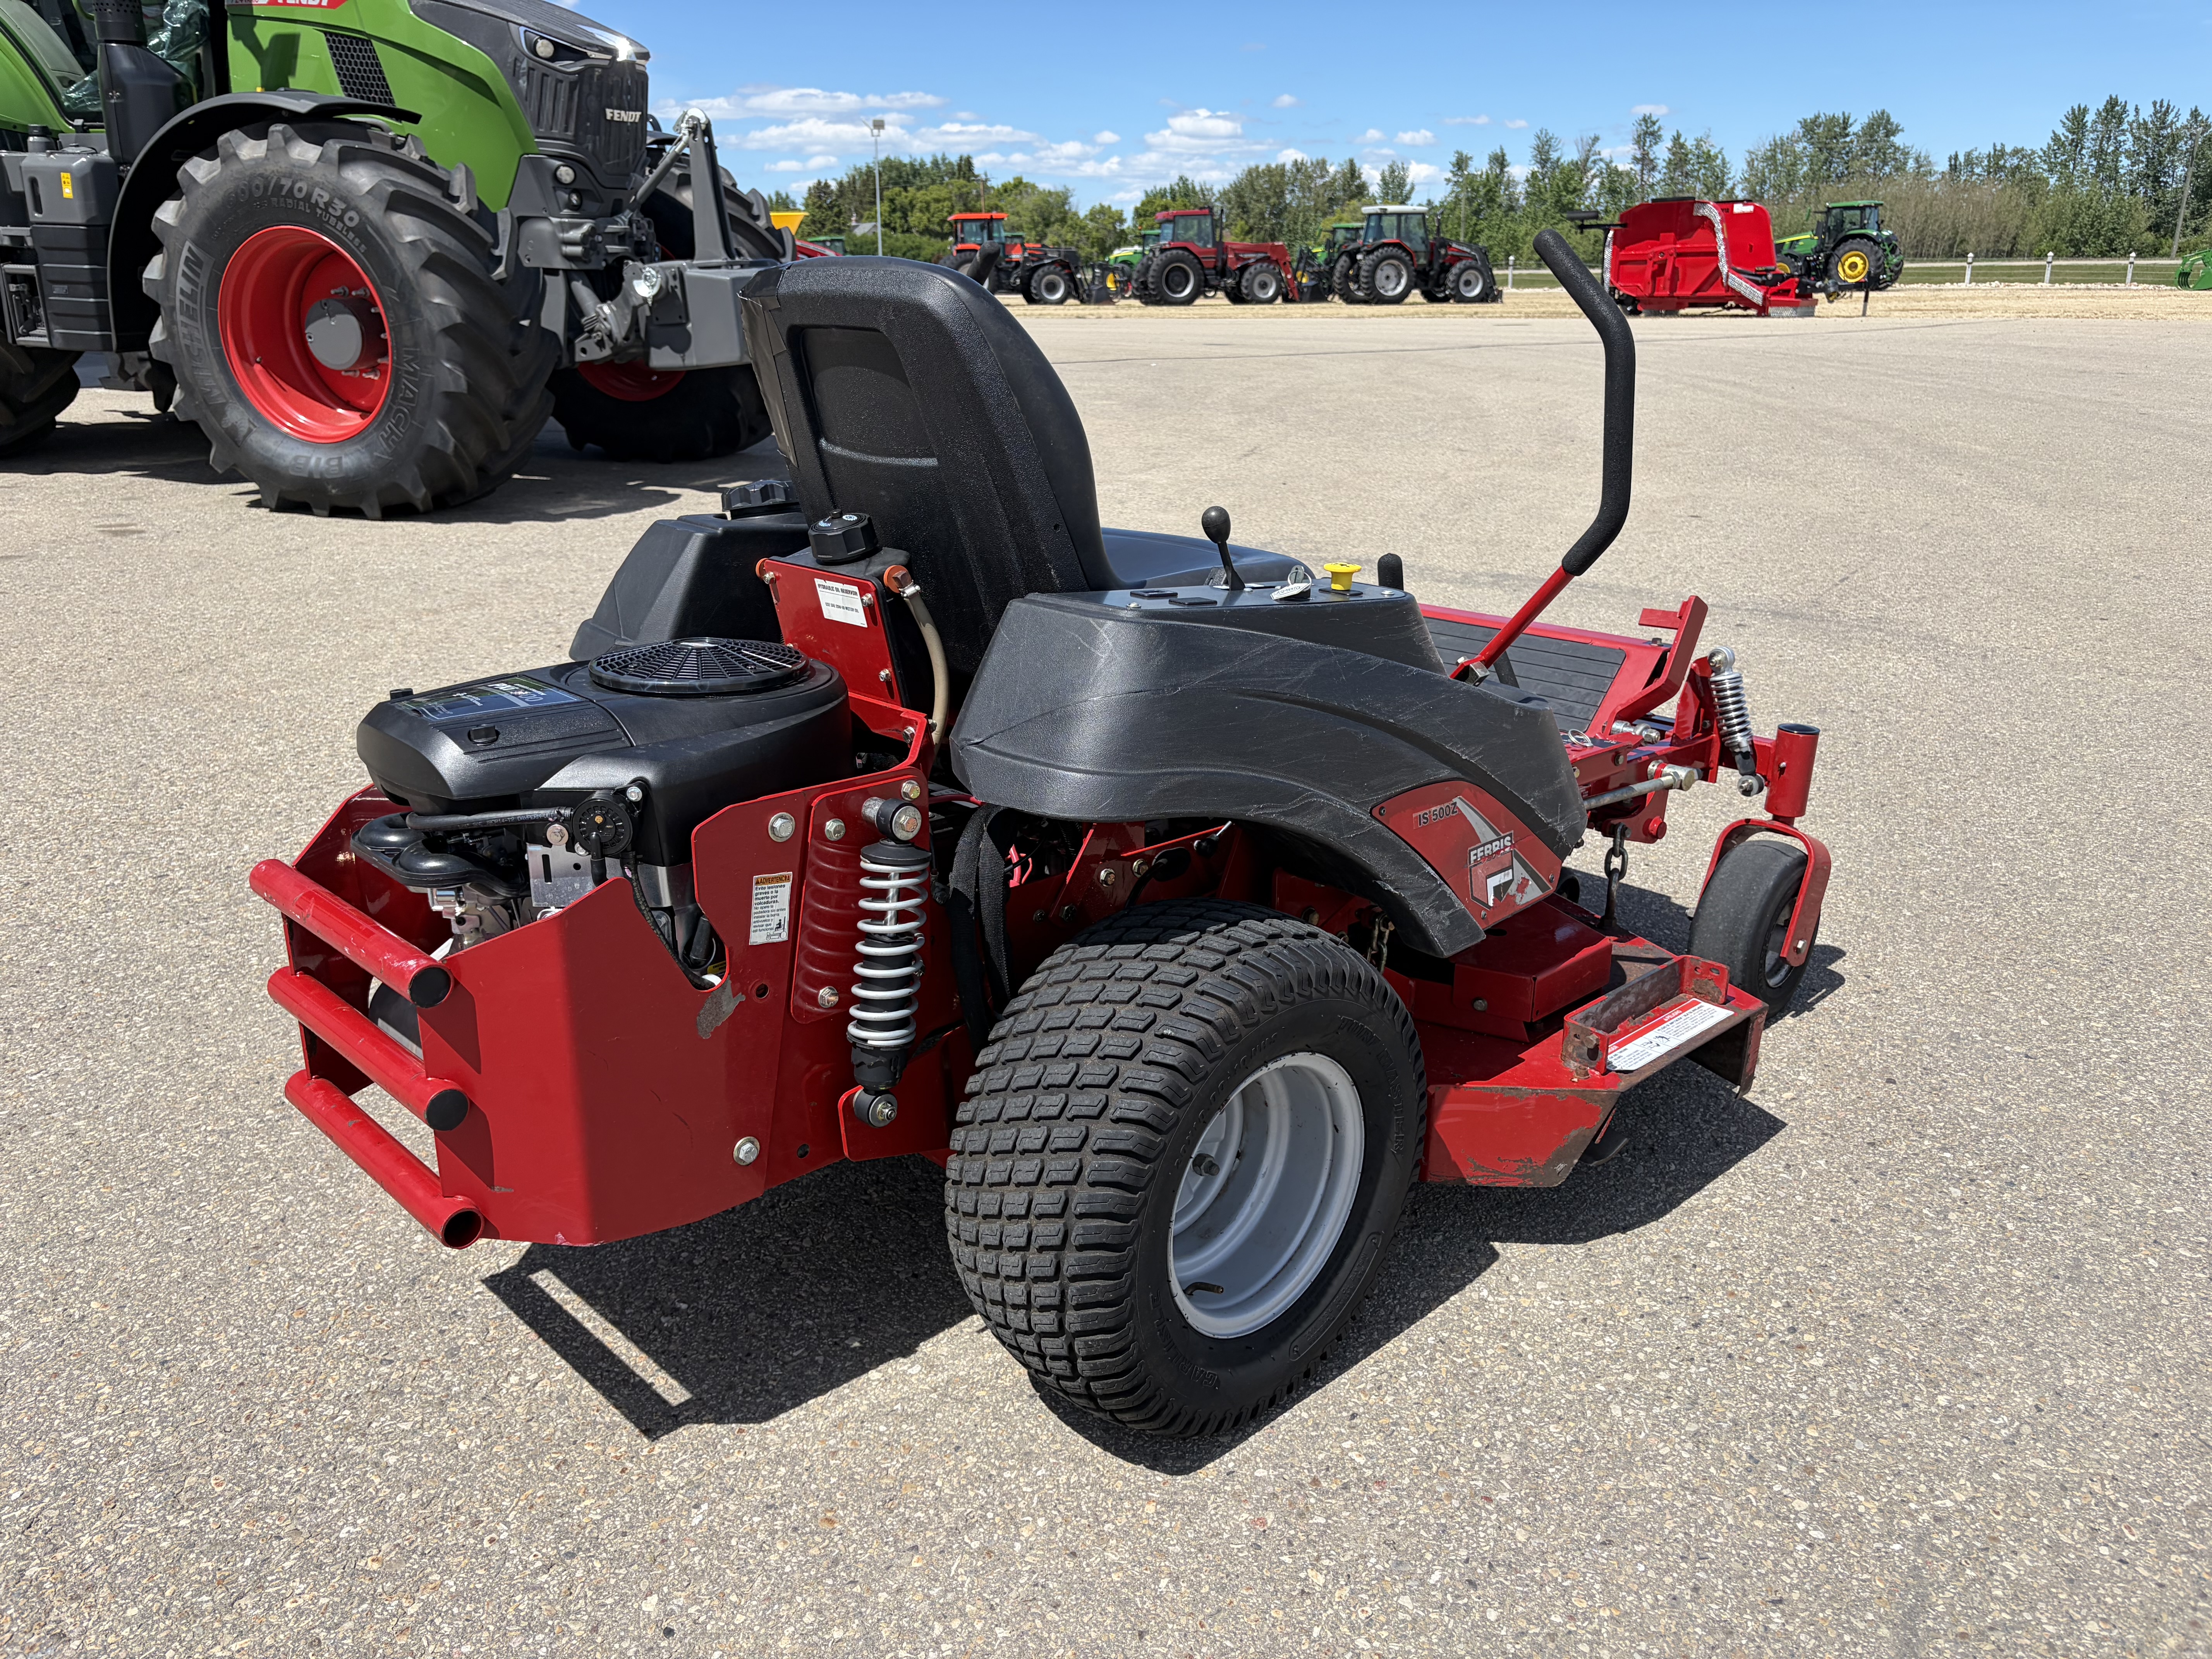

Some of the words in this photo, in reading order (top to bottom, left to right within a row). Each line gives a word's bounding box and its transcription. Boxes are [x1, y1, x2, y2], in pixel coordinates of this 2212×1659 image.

[605, 108, 642, 122] FENDT
[270, 197, 310, 213] RADIAL
[316, 208, 368, 253] TUBELESS
[310, 187, 360, 228] R30
[179, 245, 227, 404] MICHELIN
[1418, 812, 1429, 826] IS
[1432, 801, 1458, 821] 500Z
[1470, 836, 1511, 864] FERRIS
[760, 875, 790, 884] ADVERTENCIA
[1337, 1014, 1382, 1047] TURF
[1376, 1048, 1406, 1154] MASTER
[1150, 1290, 1218, 1388] CARLISLE
